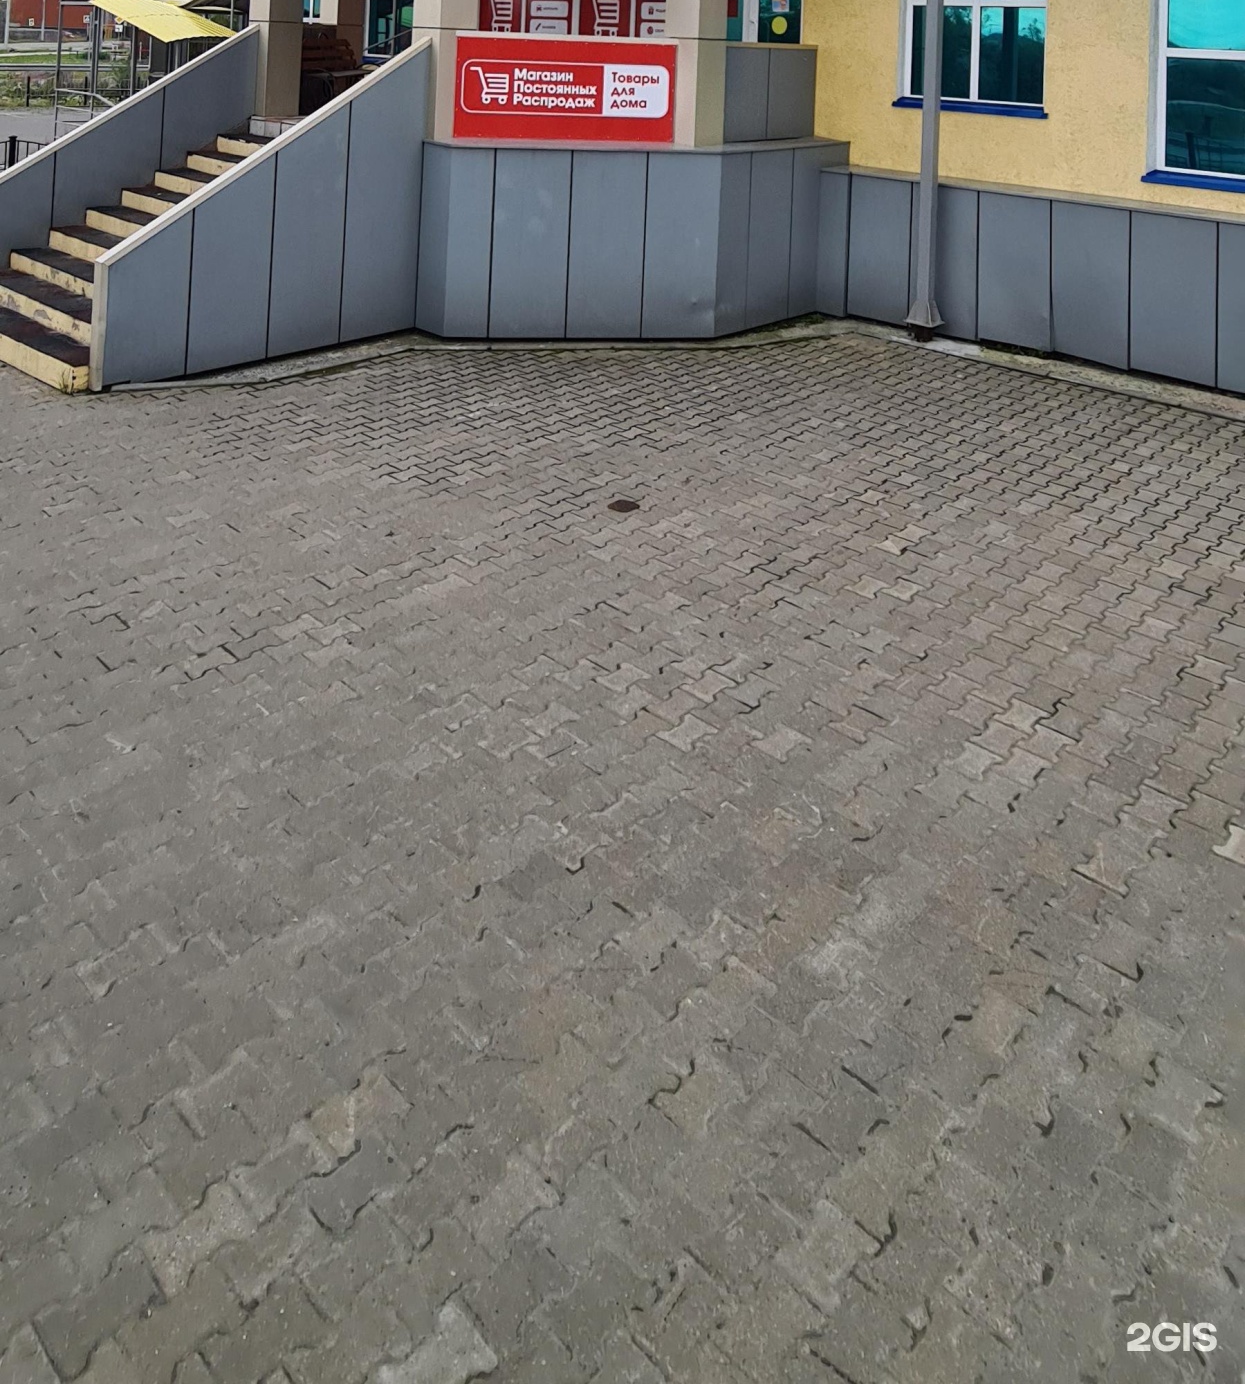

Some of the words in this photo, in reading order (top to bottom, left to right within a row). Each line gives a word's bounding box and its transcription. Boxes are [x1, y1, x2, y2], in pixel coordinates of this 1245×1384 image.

[513, 67, 574, 82] Магазин
[611, 71, 660, 86] Товары
[513, 81, 598, 96] Постоянных
[611, 86, 635, 97] для
[512, 94, 596, 109] Распродаж
[610, 98, 647, 109] дома
